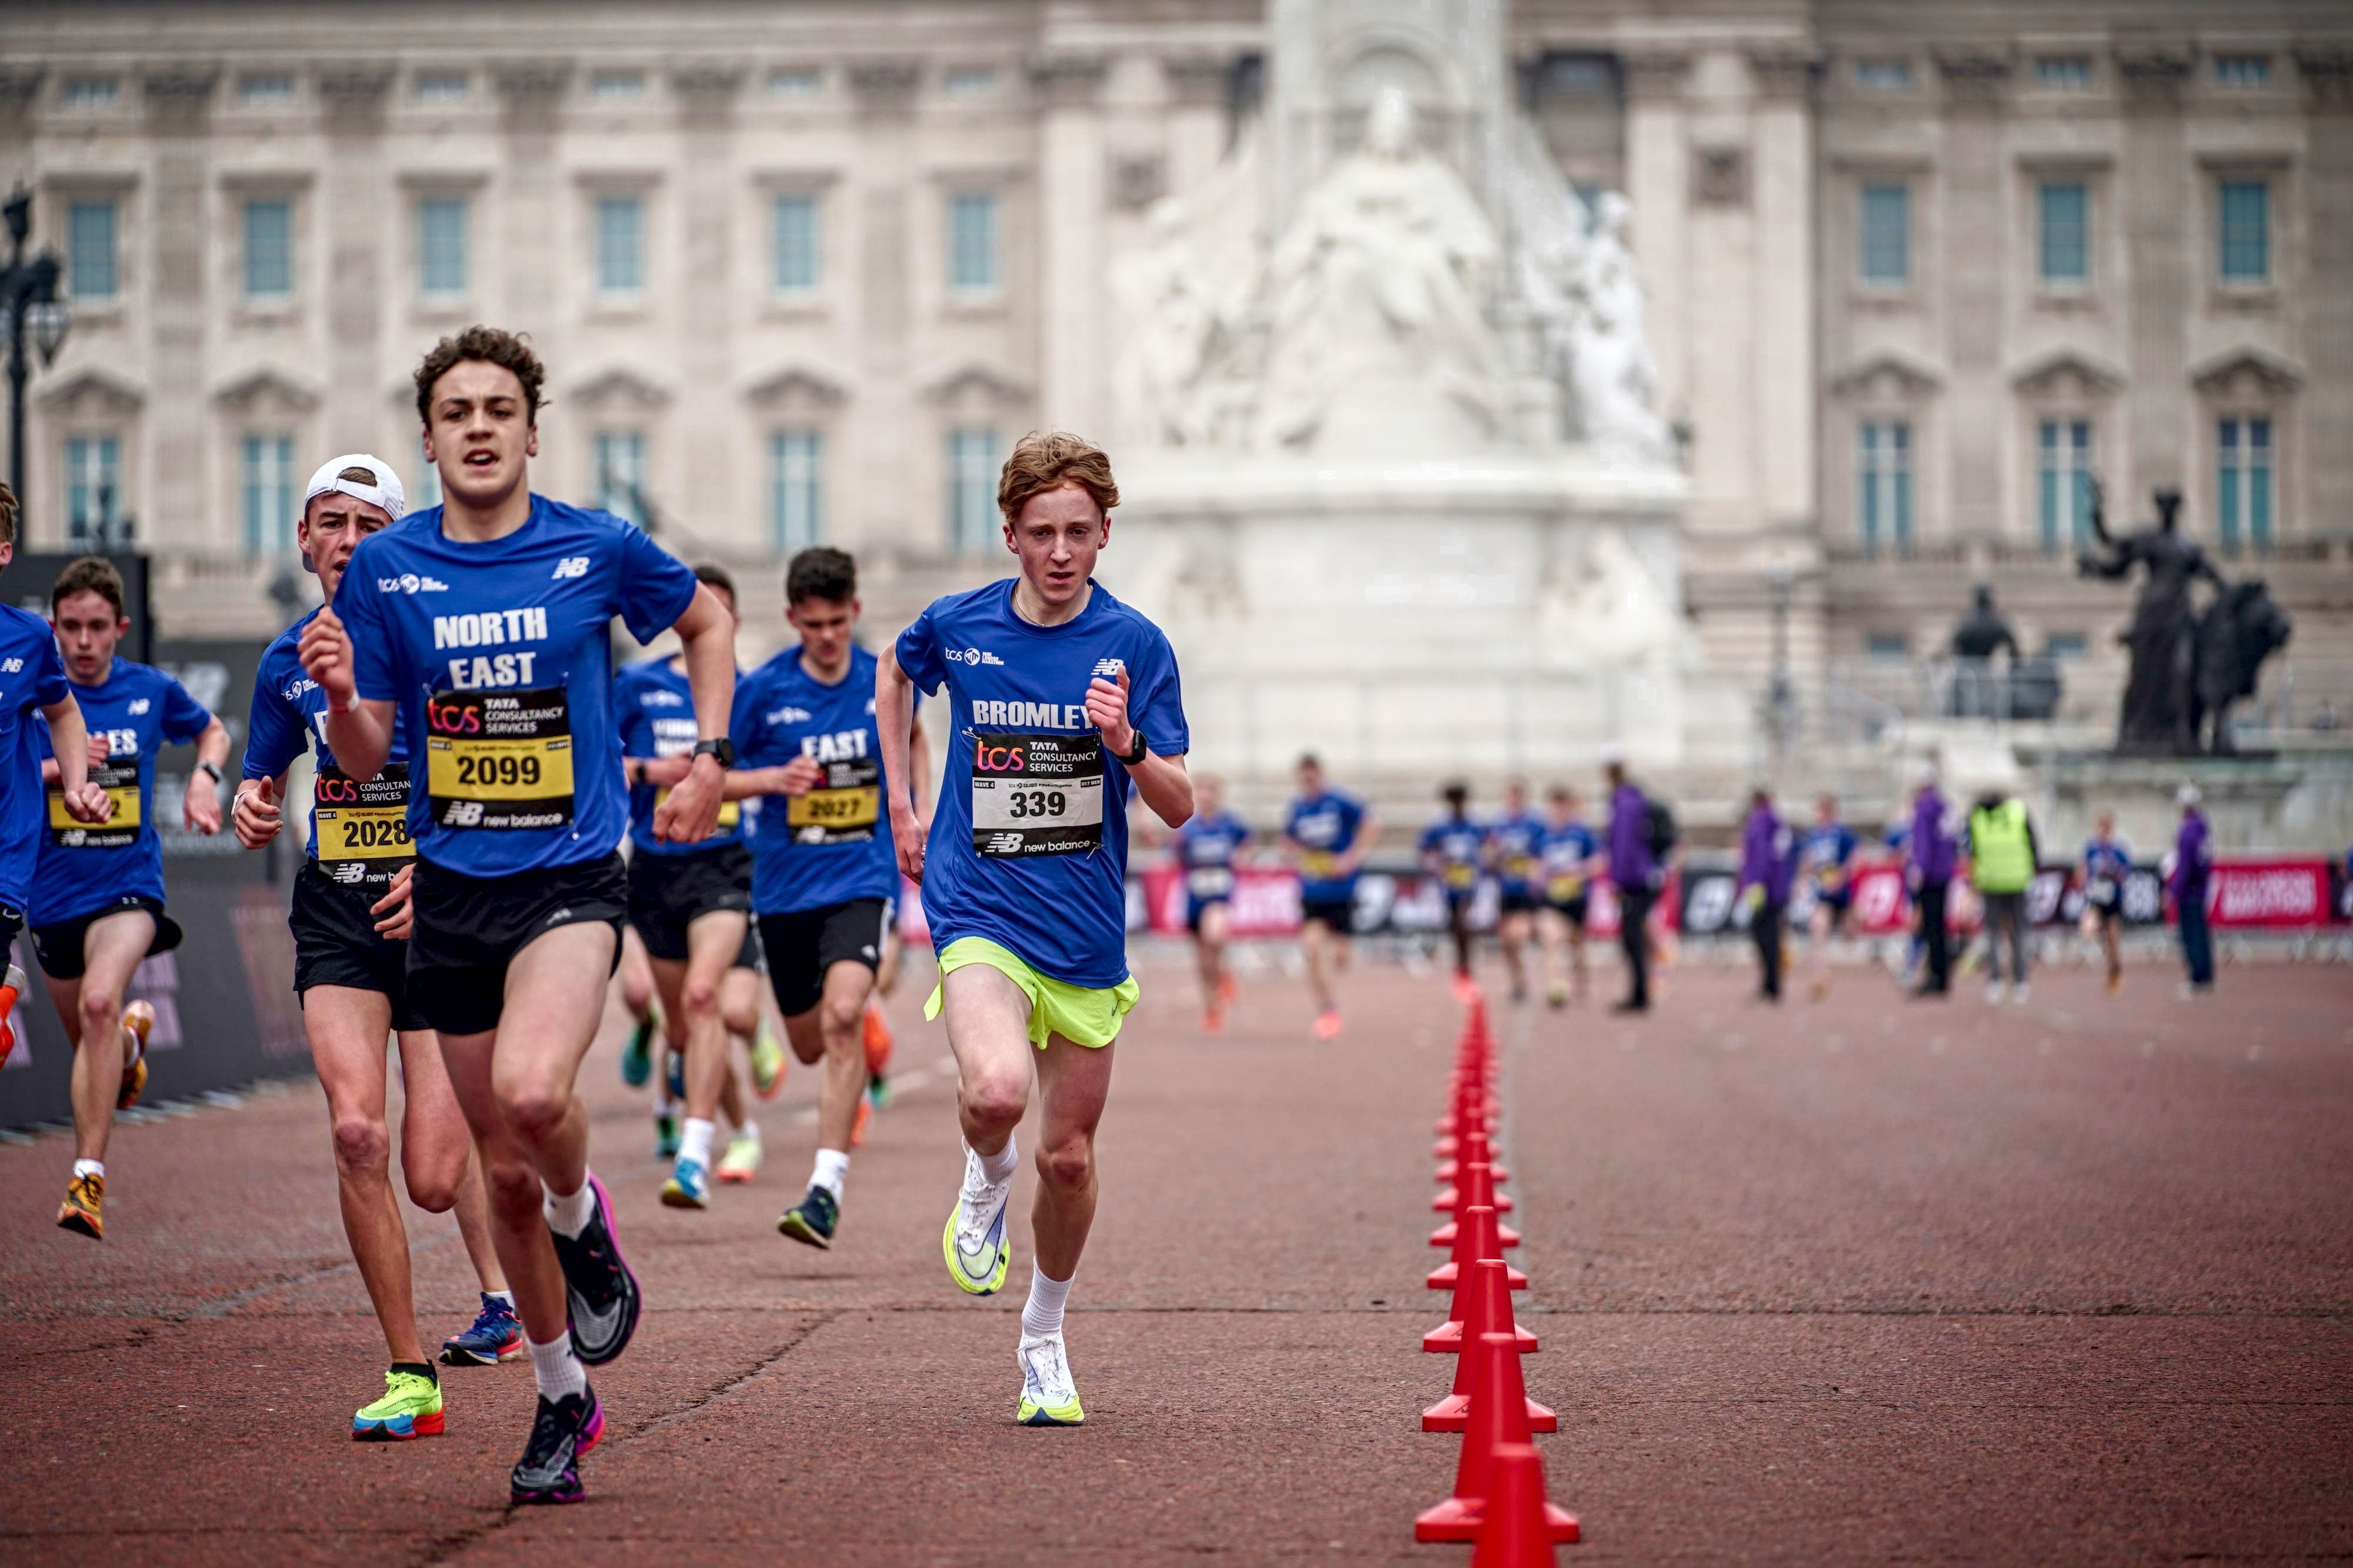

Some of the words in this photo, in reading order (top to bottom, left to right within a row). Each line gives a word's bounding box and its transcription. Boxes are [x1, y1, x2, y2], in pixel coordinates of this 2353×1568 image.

[378, 577, 399, 593] tcs
[434, 607, 548, 649] NORTH
[945, 647, 963, 662] tcs
[449, 652, 536, 690] EAST
[484, 698, 521, 709] TATA
[428, 698, 481, 733] tcs
[484, 706, 565, 722] CONSULTANCY
[972, 700, 1093, 730] BROMLEY
[485, 721, 538, 734] SERVICES
[1029, 742, 1059, 752] TATA
[976, 740, 1024, 771] tcs
[1029, 751, 1097, 762] CONSULTANCY
[457, 755, 541, 786] 2099
[1029, 763, 1074, 773] SERVICES
[317, 773, 357, 802] tcs
[359, 780, 411, 792] CONSULTAN
[362, 791, 402, 802] SERVICES
[808, 797, 861, 818] 2027
[1010, 792, 1066, 818] 339
[482, 815, 509, 828] new
[510, 812, 563, 828] balance
[344, 819, 411, 848] 2028
[1024, 843, 1046, 853] new
[1048, 840, 1091, 852] balance
[366, 873, 386, 883] new
